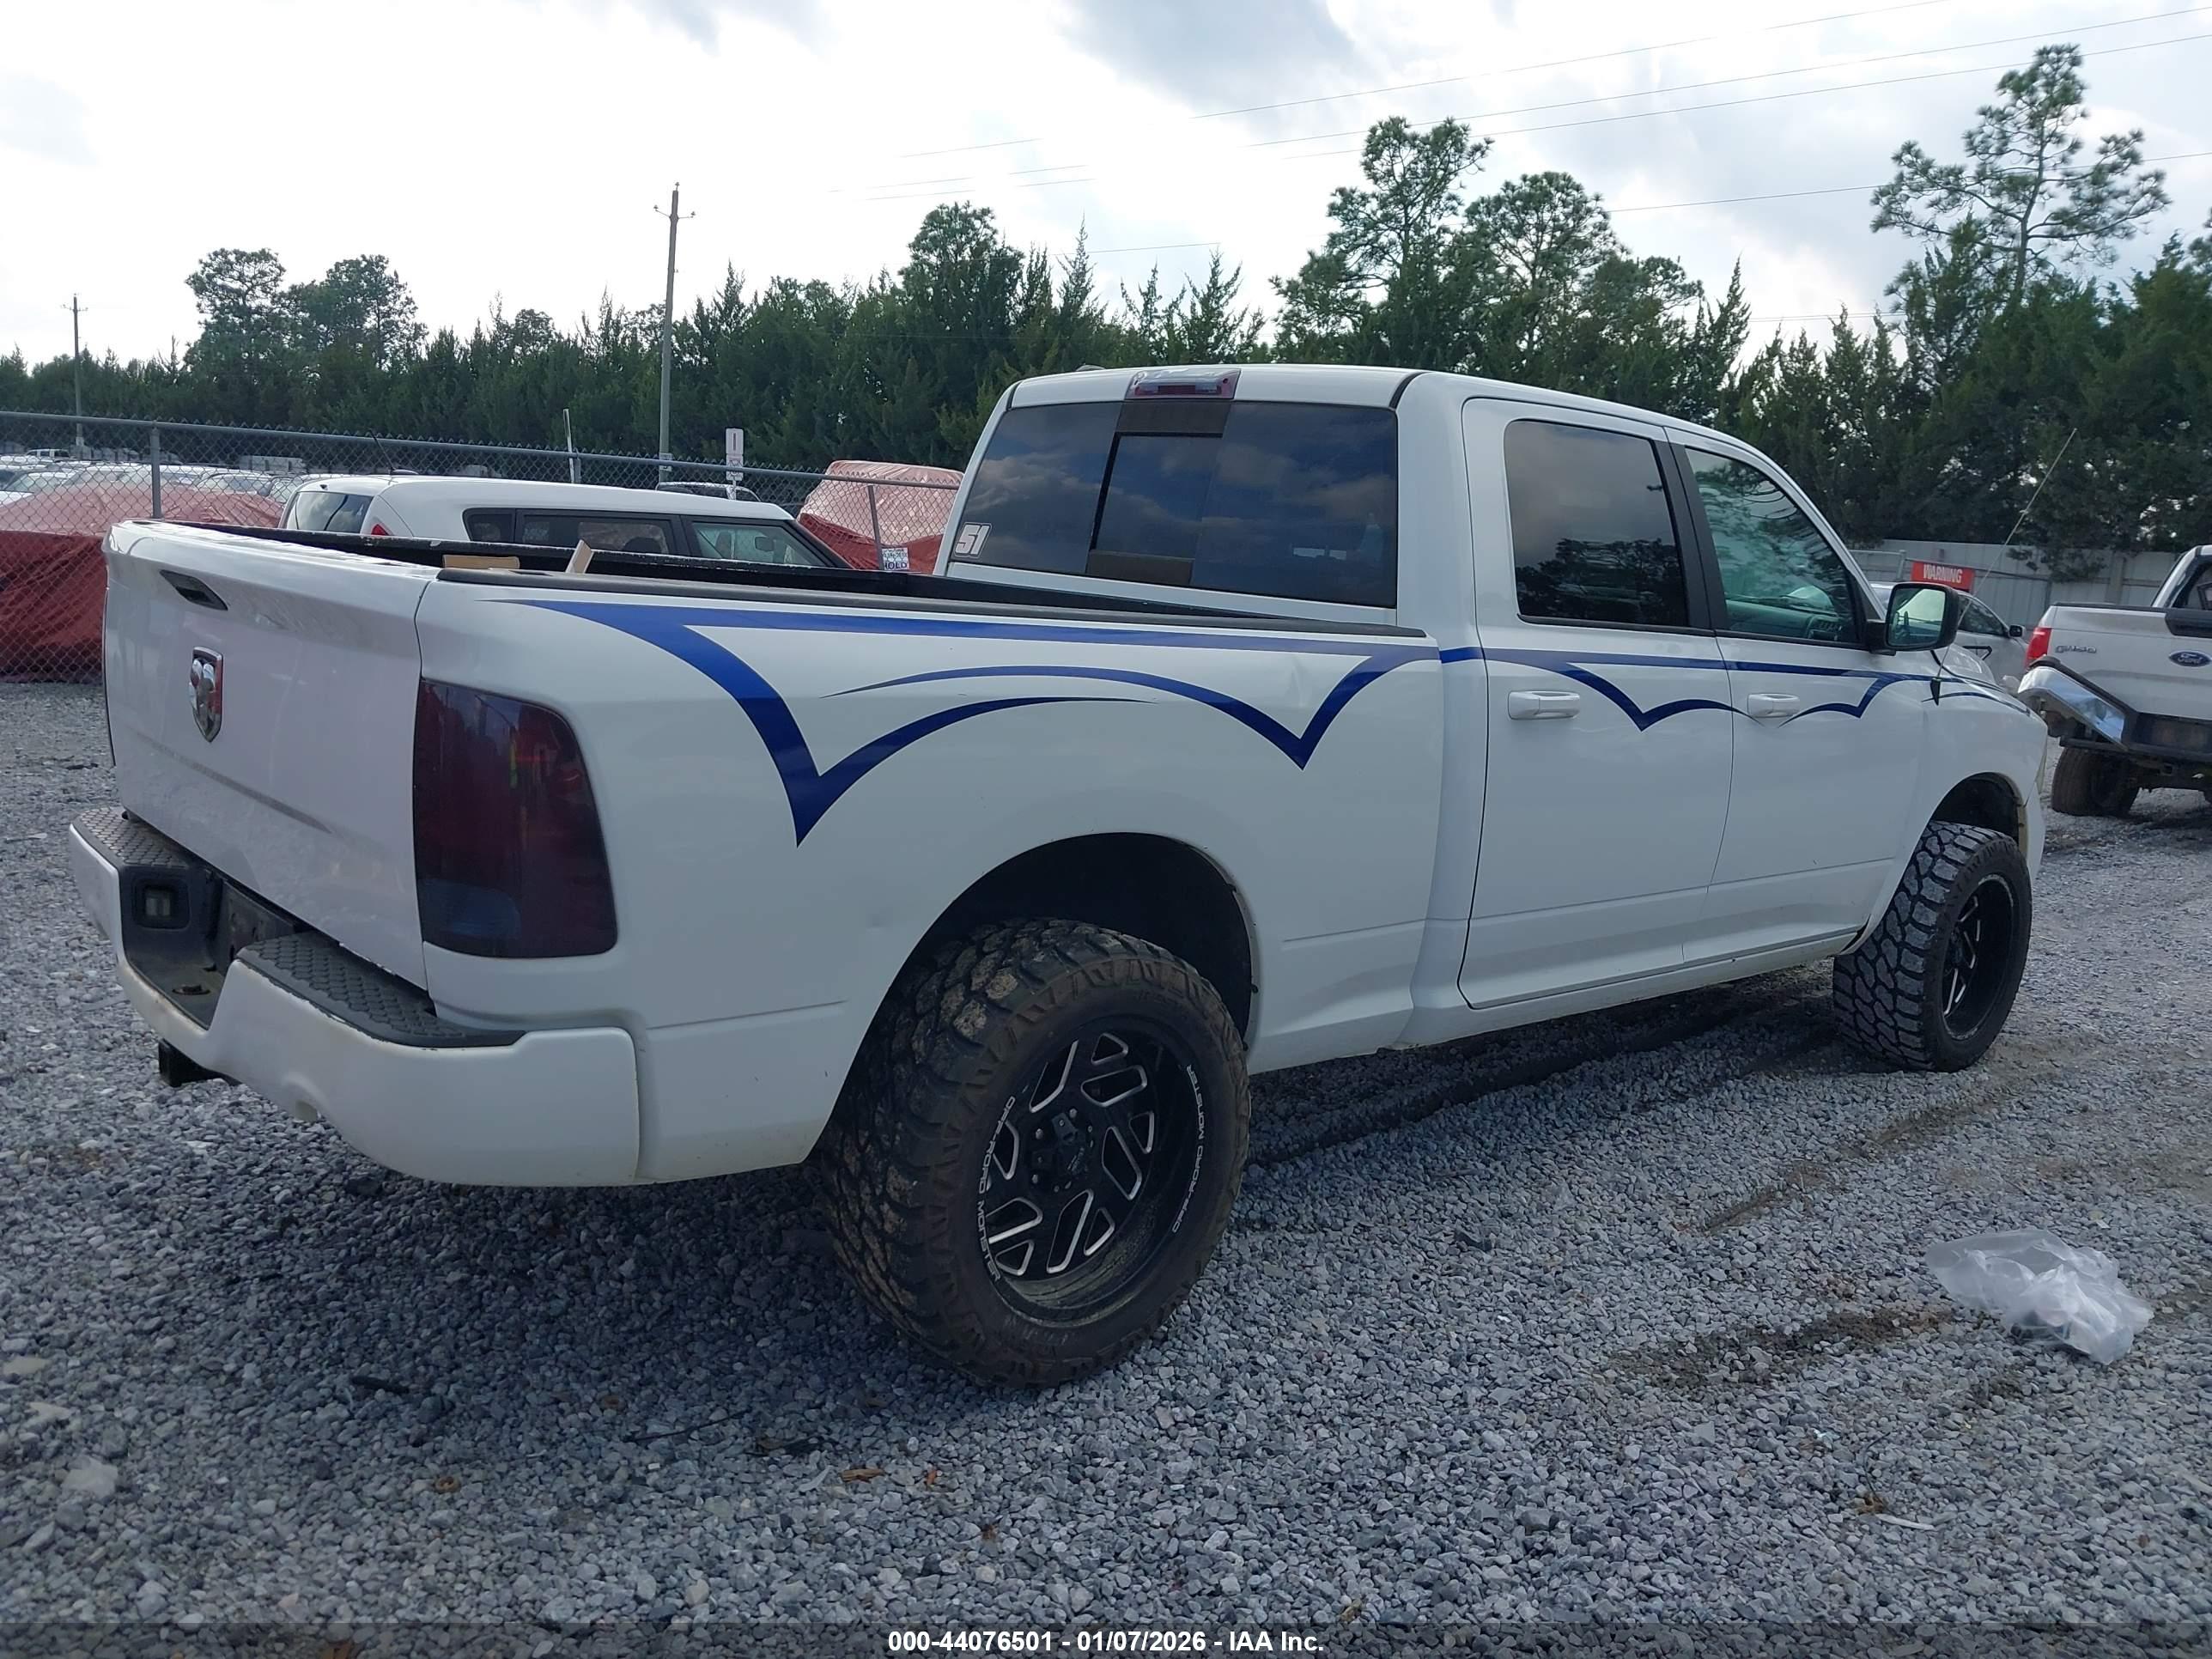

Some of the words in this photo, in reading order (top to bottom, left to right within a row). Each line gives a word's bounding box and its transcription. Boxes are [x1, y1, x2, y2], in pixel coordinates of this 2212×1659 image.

[954, 523, 991, 556] 51
[1923, 563, 1963, 584] WARNING
[1186, 1064, 1206, 1140] MONSTER
[978, 1095, 1016, 1194] OFF-ROAD
[1171, 1145, 1204, 1233] OFF-ROAD
[976, 1199, 1001, 1282] MONSTER
